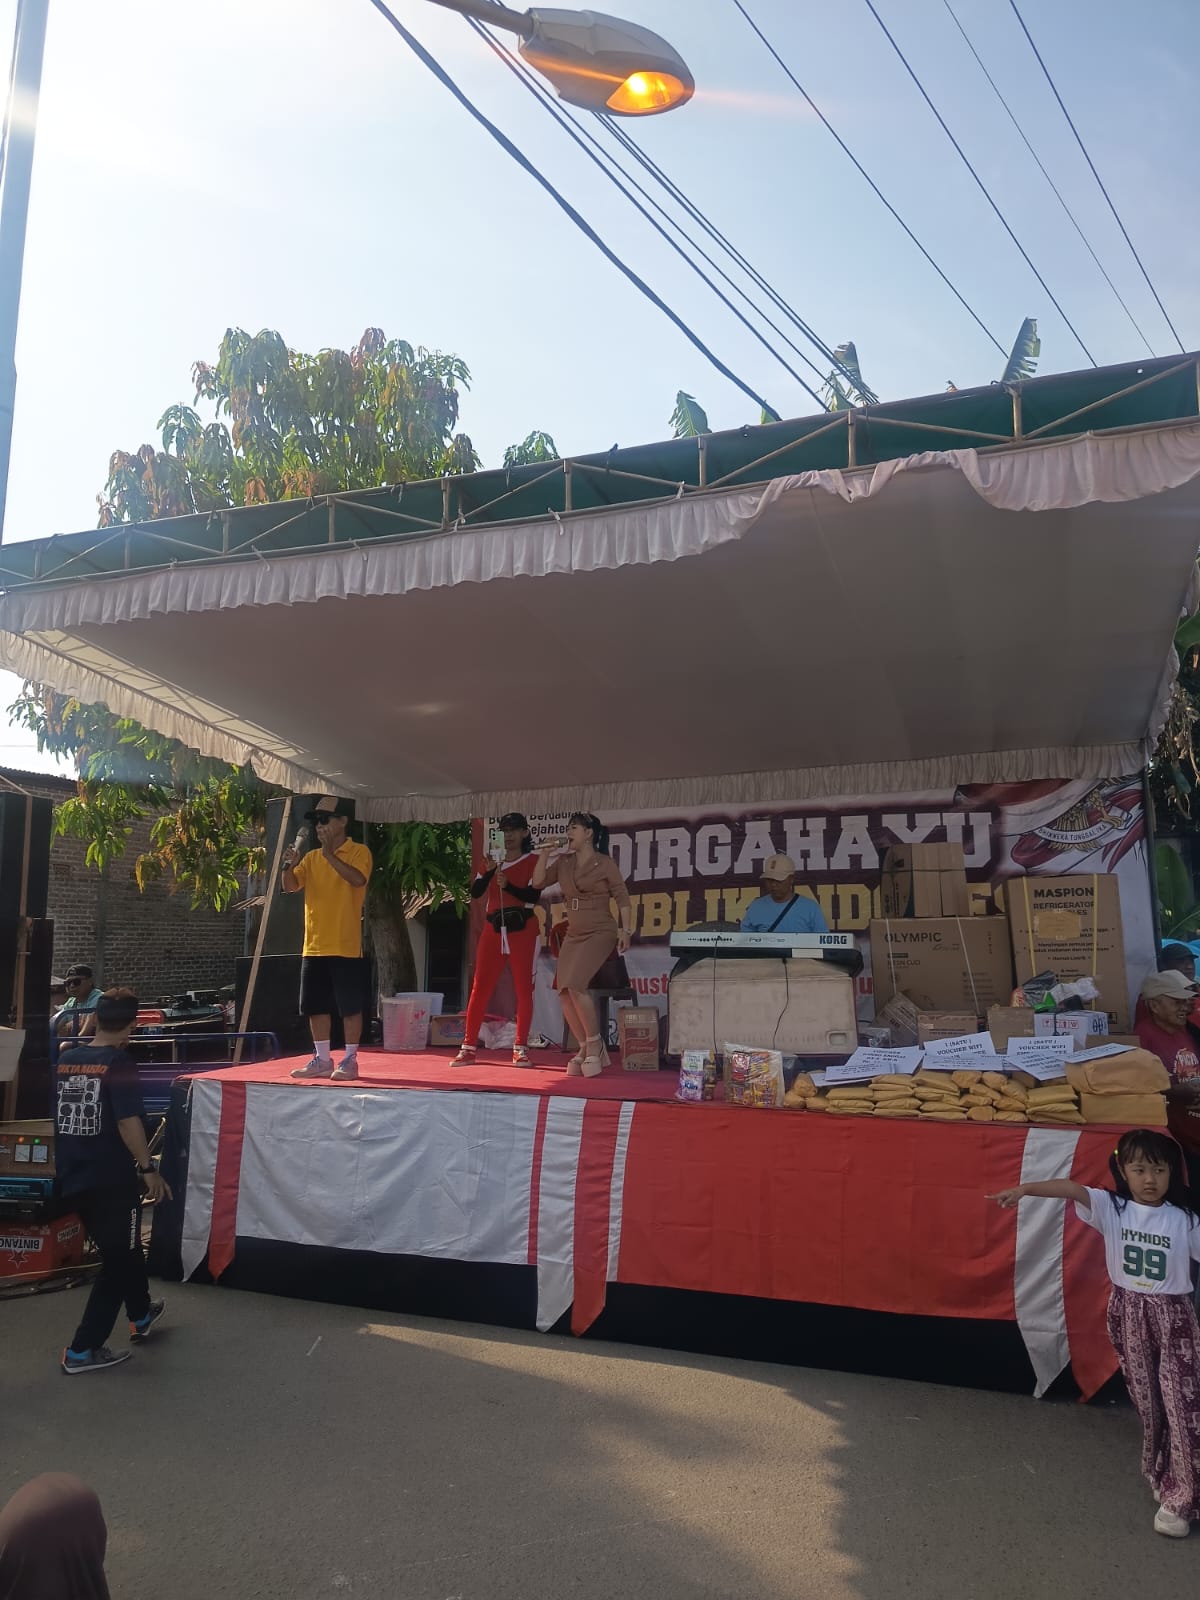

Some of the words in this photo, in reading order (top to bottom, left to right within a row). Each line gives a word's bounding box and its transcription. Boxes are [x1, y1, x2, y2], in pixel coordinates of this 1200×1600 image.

[1034, 887, 1095, 898] MASPION
[819, 935, 848, 944] KORG
[884, 932, 942, 943] OLYMPIC
[1123, 1245, 1167, 1281] 99
